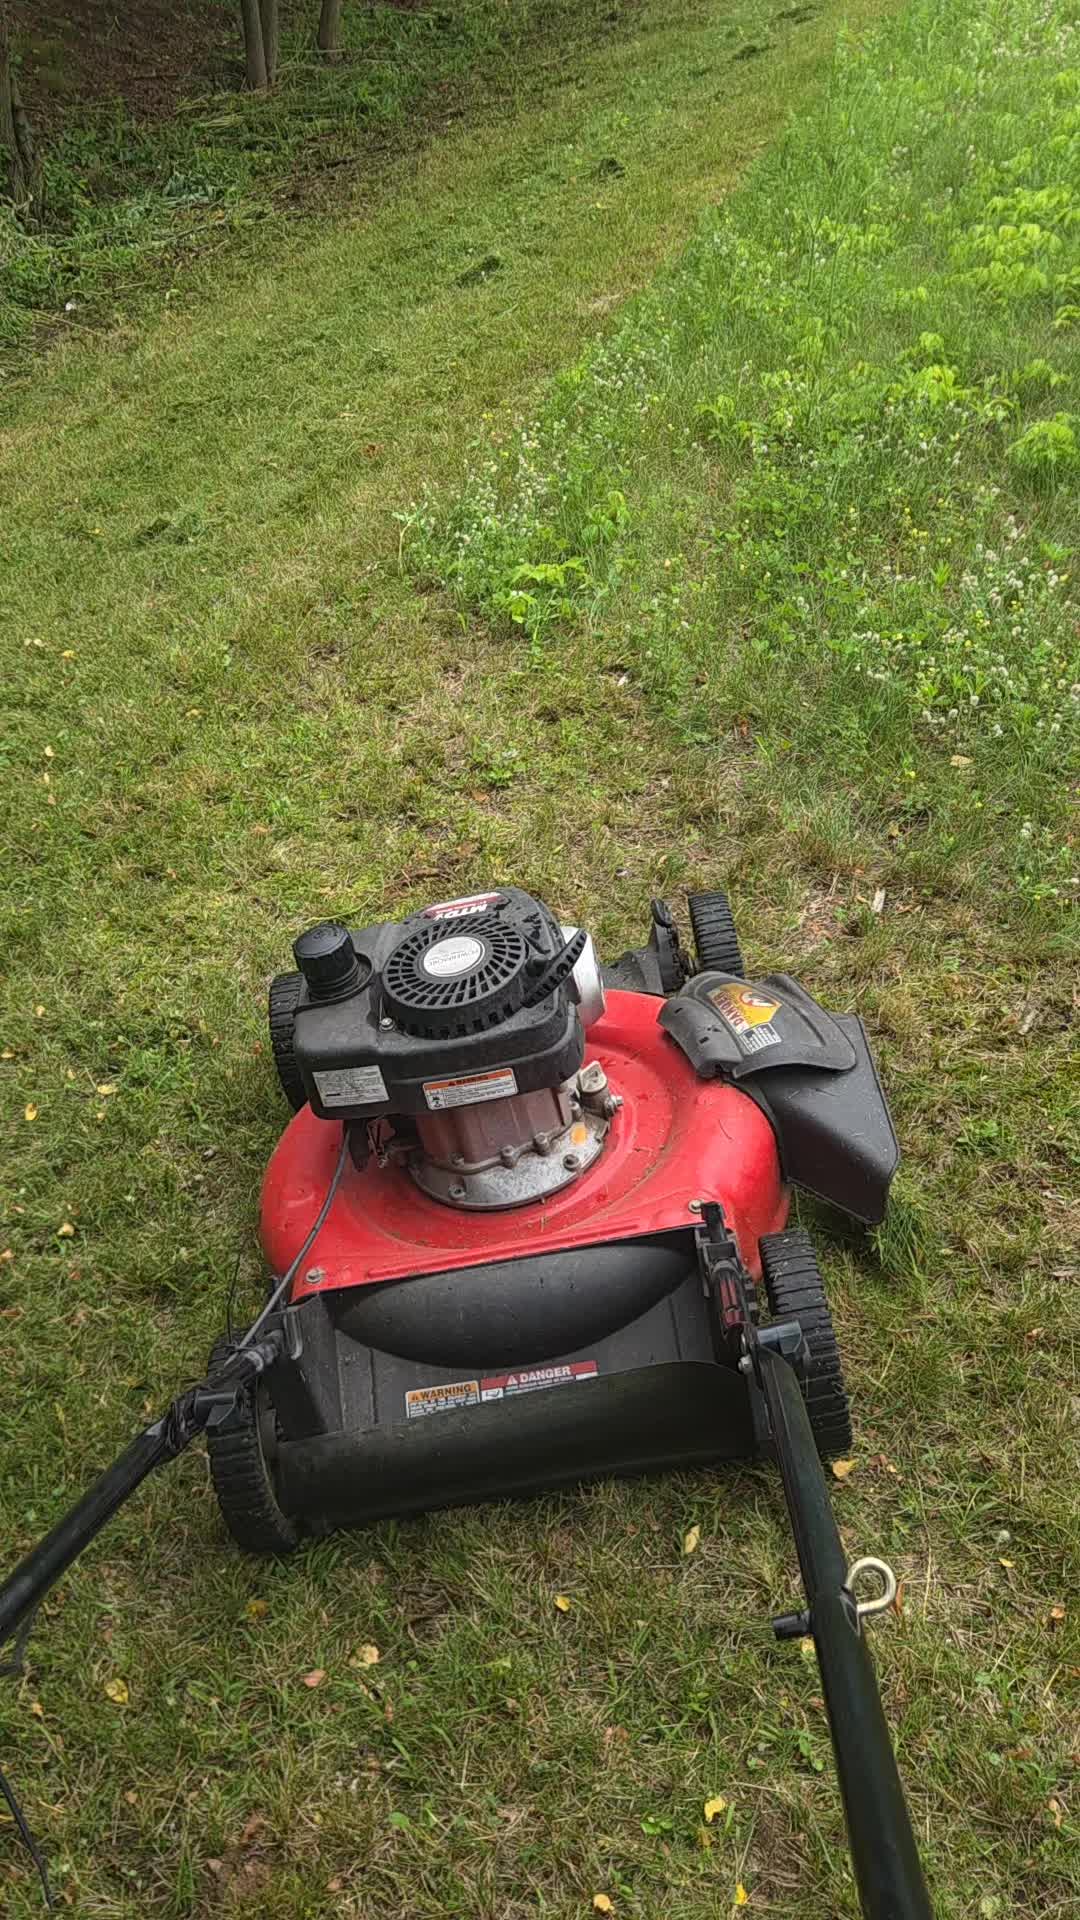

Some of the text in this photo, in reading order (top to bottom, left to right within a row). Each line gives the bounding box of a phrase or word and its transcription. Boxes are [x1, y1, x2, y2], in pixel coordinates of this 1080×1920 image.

[712, 990, 746, 1027] DANGER
[520, 1366, 571, 1383] DANGER
[420, 1383, 472, 1400] WARNING
